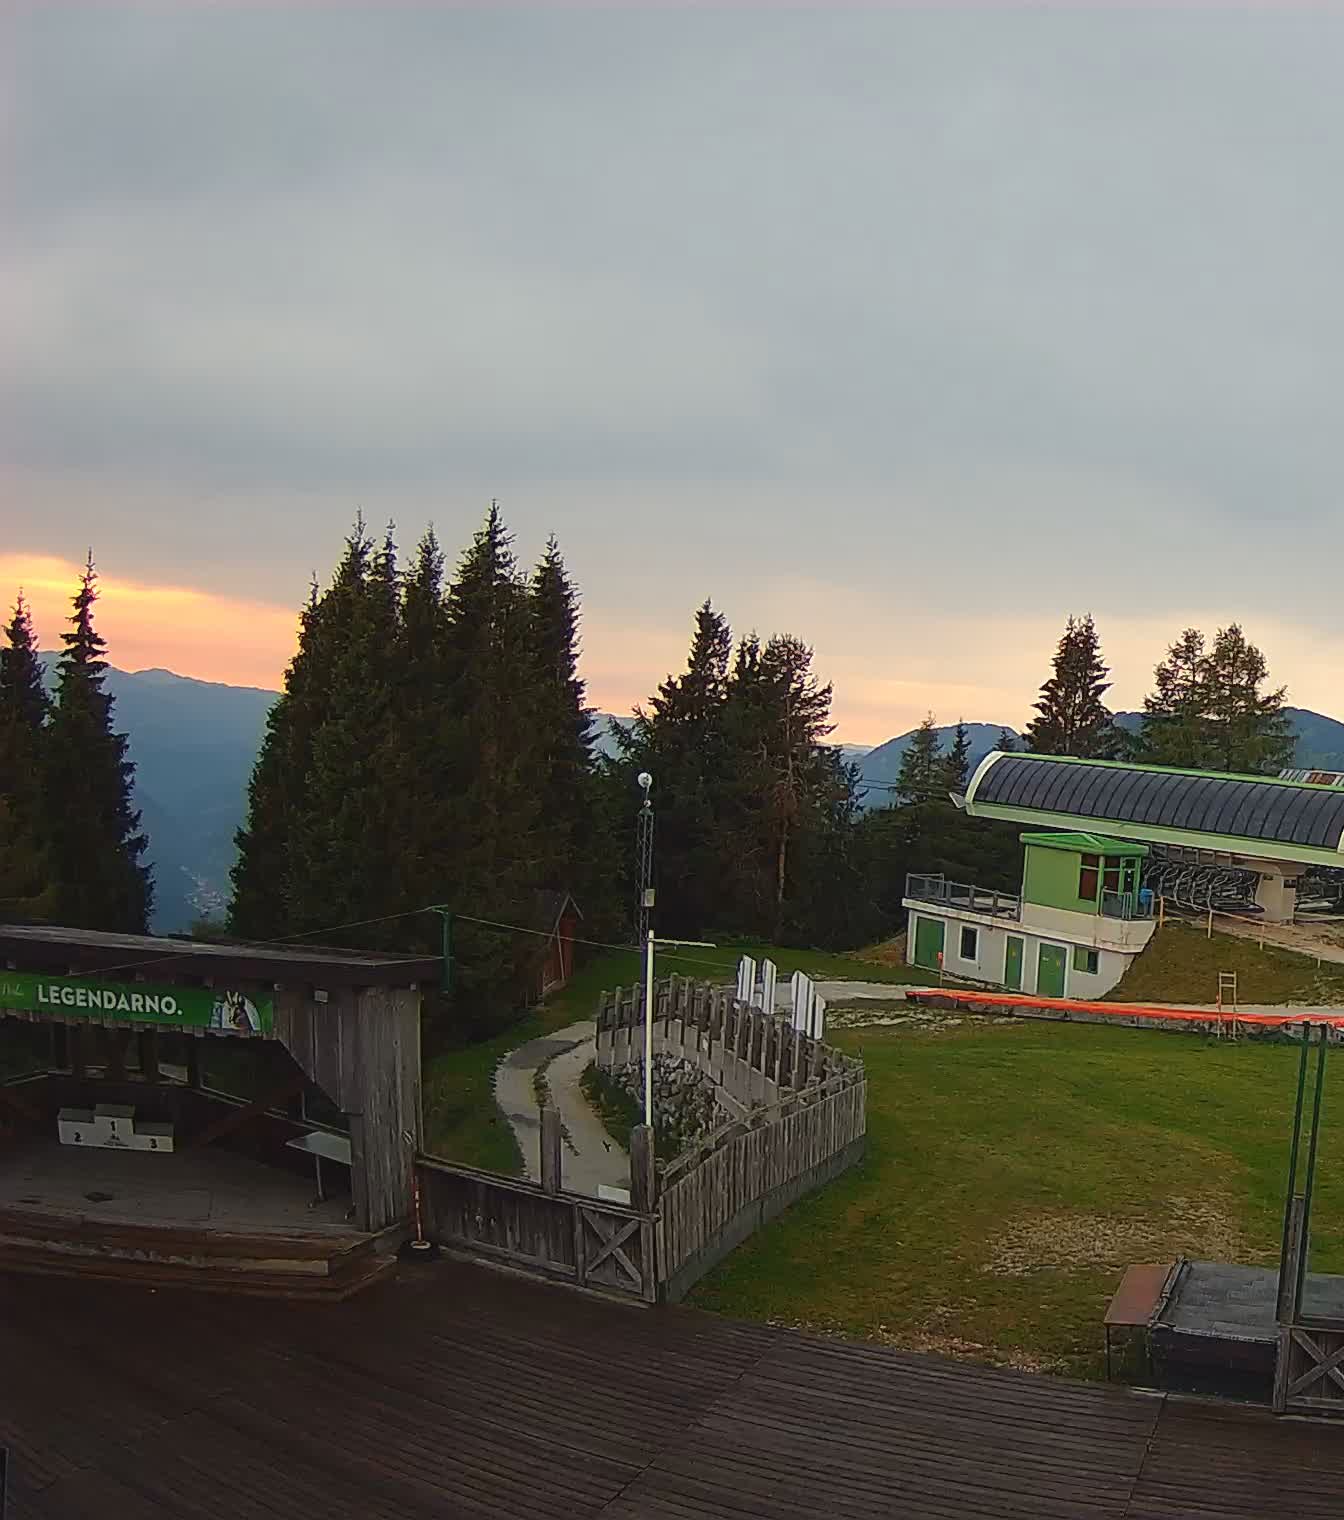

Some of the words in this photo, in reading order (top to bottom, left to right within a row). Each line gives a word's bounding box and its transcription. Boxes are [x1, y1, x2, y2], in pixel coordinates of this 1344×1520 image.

[37, 984, 183, 1016] LEGENDARNO.
[109, 1120, 117, 1132] 1
[73, 1132, 82, 1143] 2
[149, 1138, 158, 1149] 3
